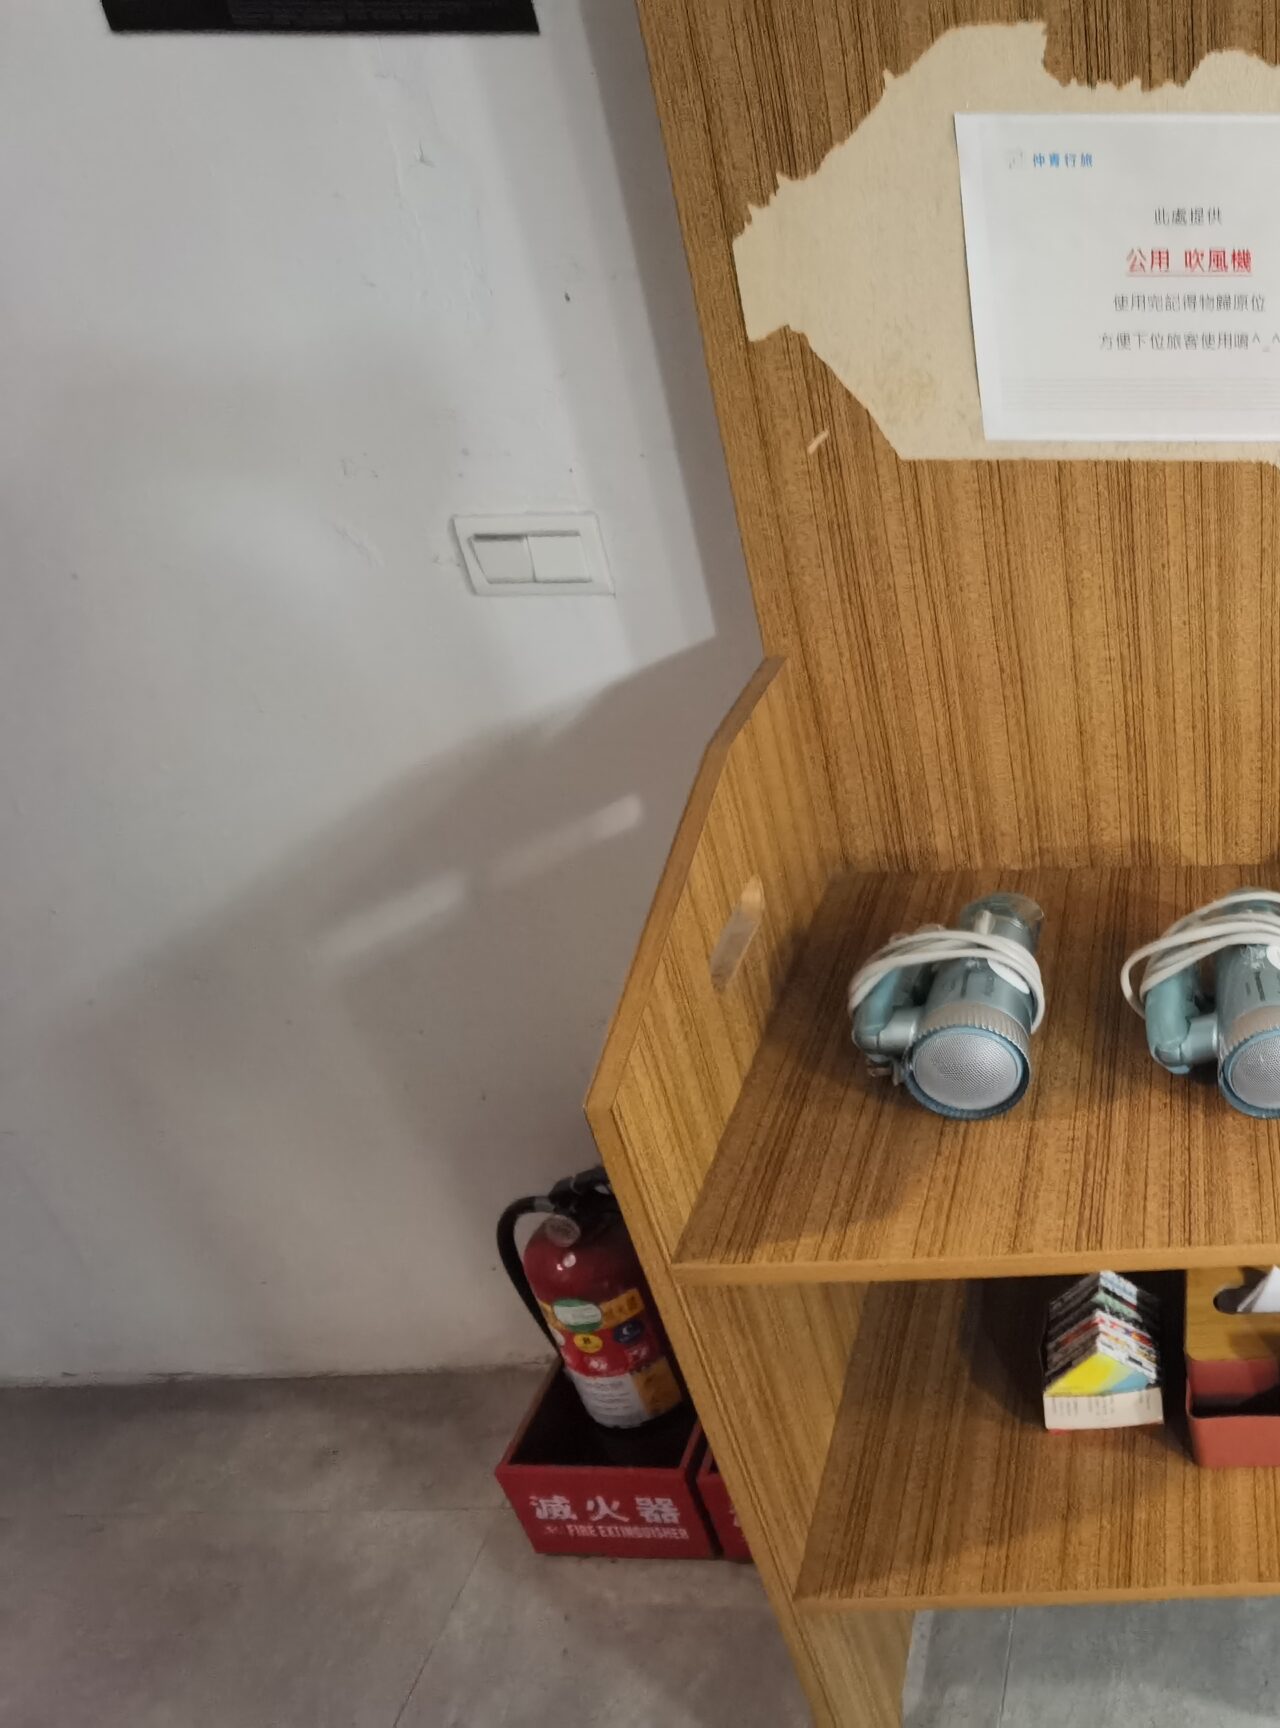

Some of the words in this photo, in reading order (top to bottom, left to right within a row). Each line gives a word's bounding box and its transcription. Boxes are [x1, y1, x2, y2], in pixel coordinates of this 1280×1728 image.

[1154, 206, 1222, 225] 此處提供
[1126, 247, 1170, 273] 公用
[1184, 247, 1252, 273] 吹風機
[1113, 292, 1265, 312] 使用完記得物歸原位
[529, 1494, 680, 1524] 滅火器
[566, 1524, 598, 1538] FIRE
[599, 1525, 689, 1540] EXTINGUISHER
